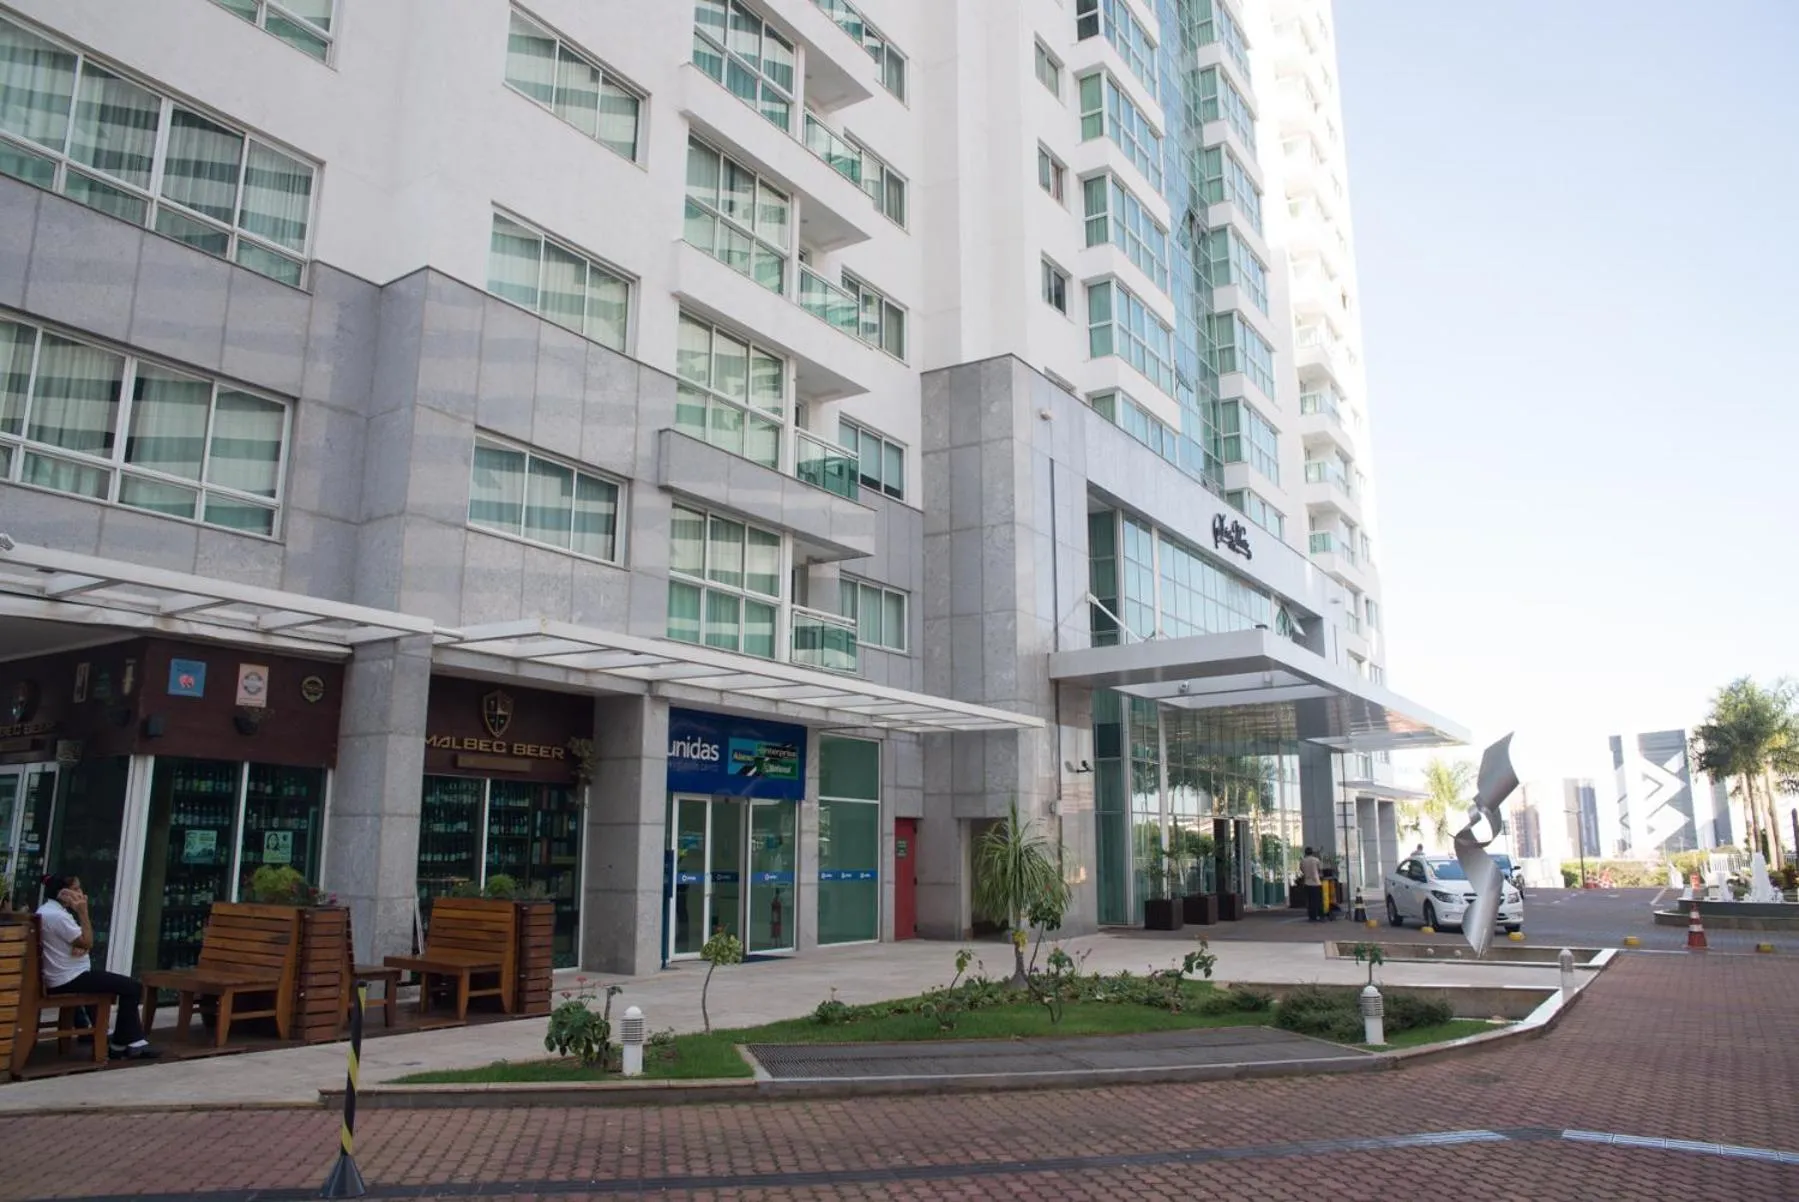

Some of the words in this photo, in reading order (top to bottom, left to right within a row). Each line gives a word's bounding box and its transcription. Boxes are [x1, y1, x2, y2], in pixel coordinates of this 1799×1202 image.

[425, 734, 507, 753] MALBEC
[512, 743, 564, 759] BEER
[666, 736, 720, 761] unidas
